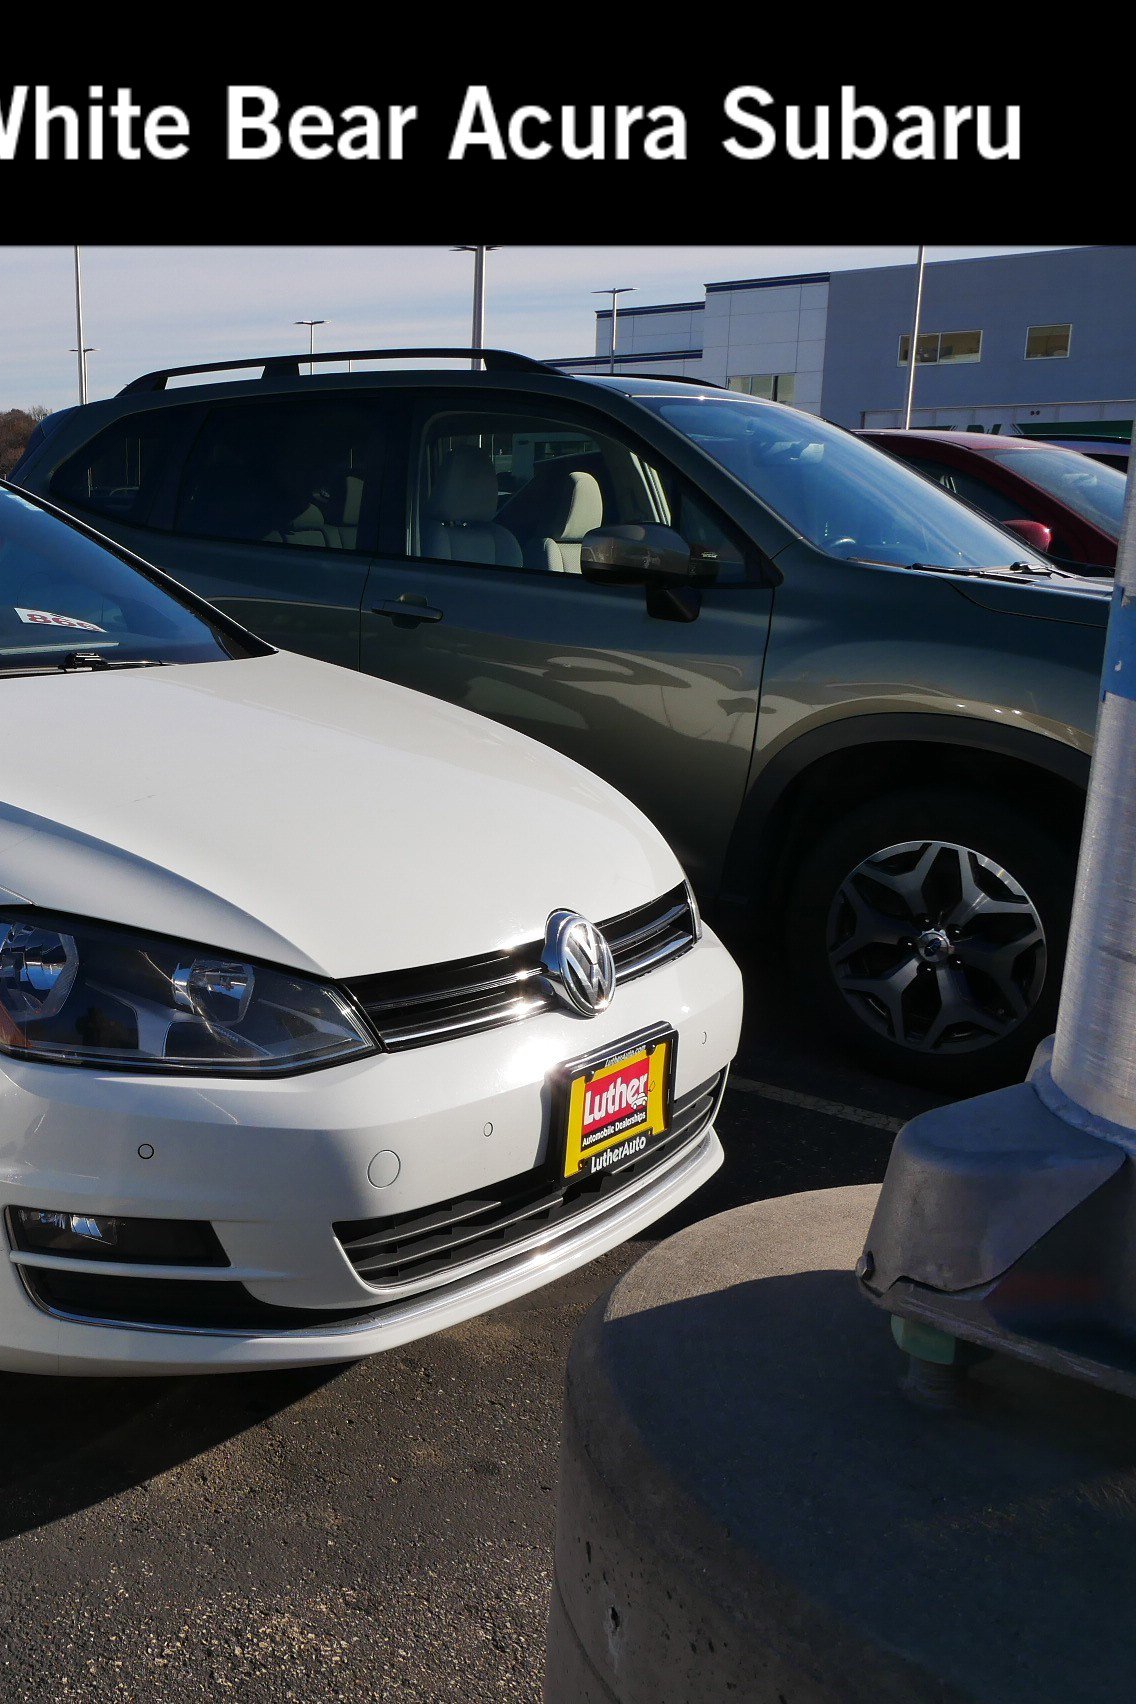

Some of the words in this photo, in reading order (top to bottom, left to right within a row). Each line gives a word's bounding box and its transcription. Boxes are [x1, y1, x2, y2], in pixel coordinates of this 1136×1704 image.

[583, 1073, 649, 1126] Luther
[582, 1124, 615, 1147] Automobile
[615, 1111, 646, 1132] Dealerships
[590, 1135, 646, 1174] LutherAuto
